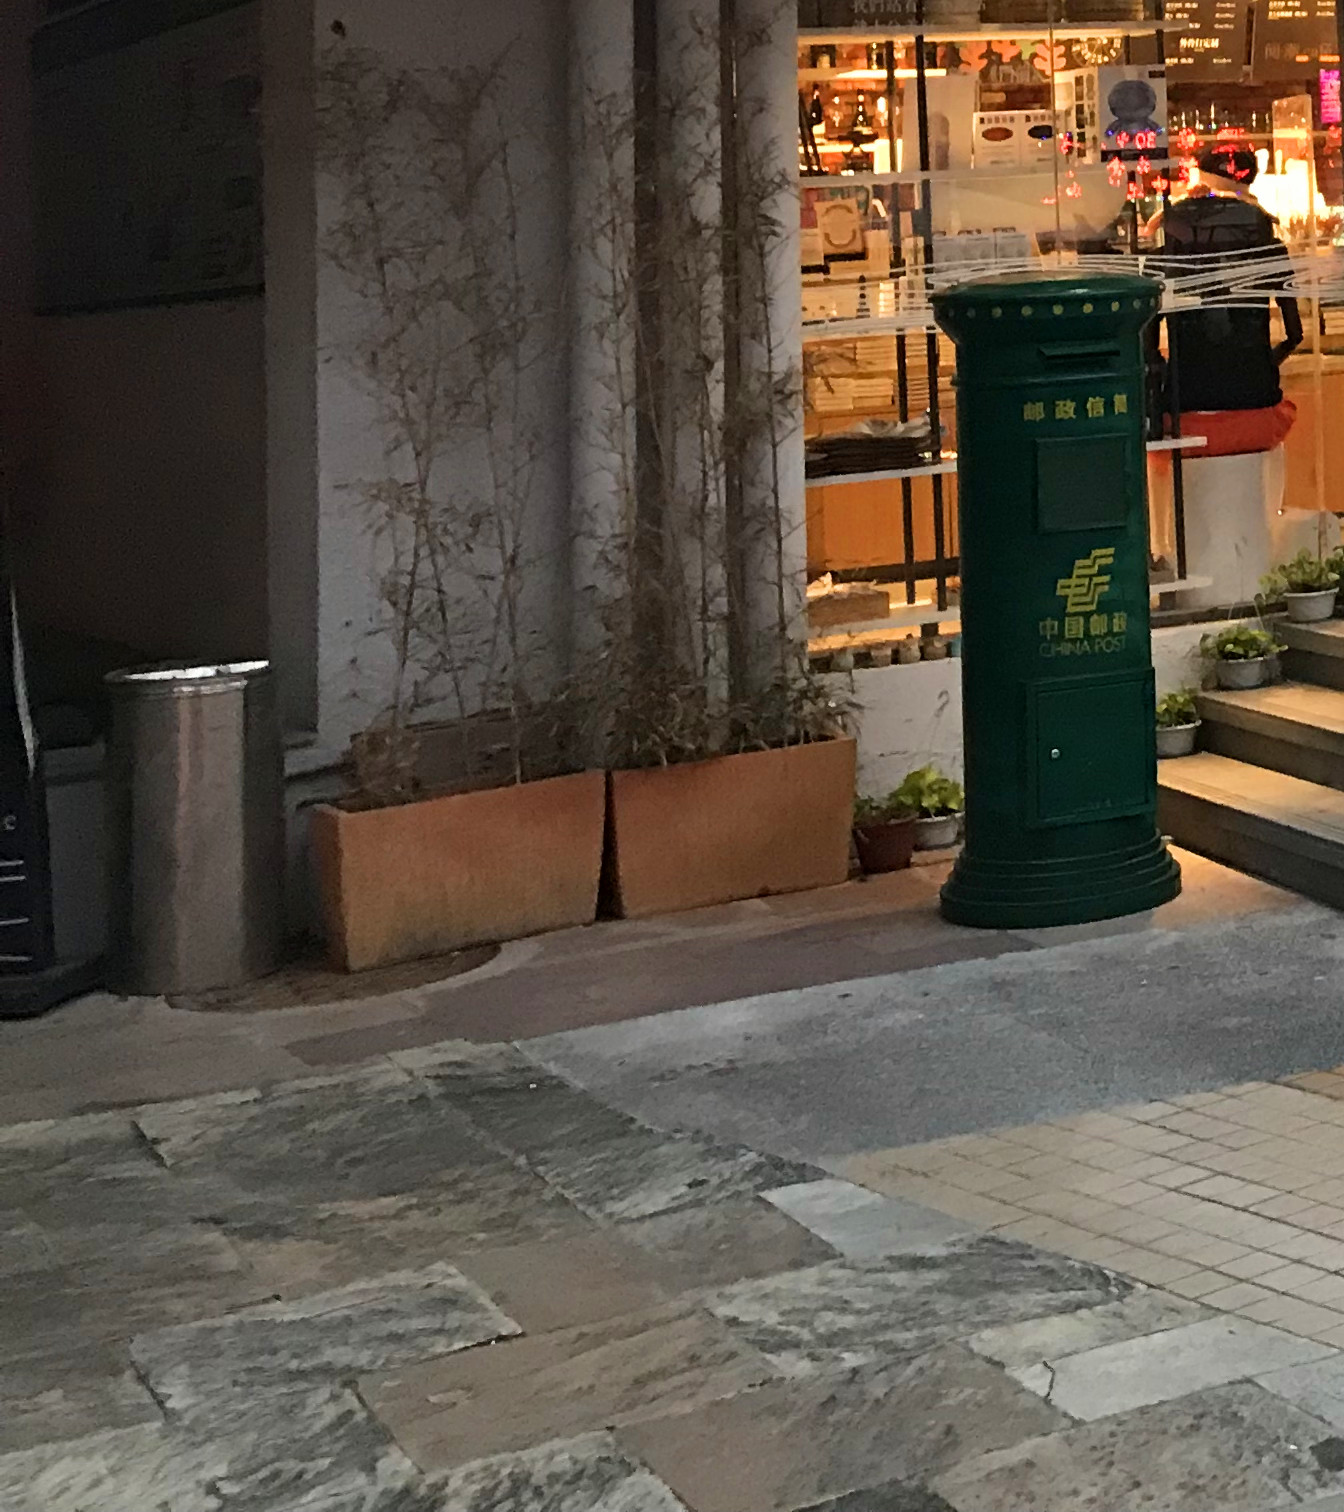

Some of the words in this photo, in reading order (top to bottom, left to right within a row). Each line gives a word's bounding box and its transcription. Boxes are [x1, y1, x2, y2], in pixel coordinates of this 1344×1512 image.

[1039, 611, 1128, 640] 中国邮政
[1040, 639, 1092, 658] CHINA
[1094, 635, 1127, 655] POST
